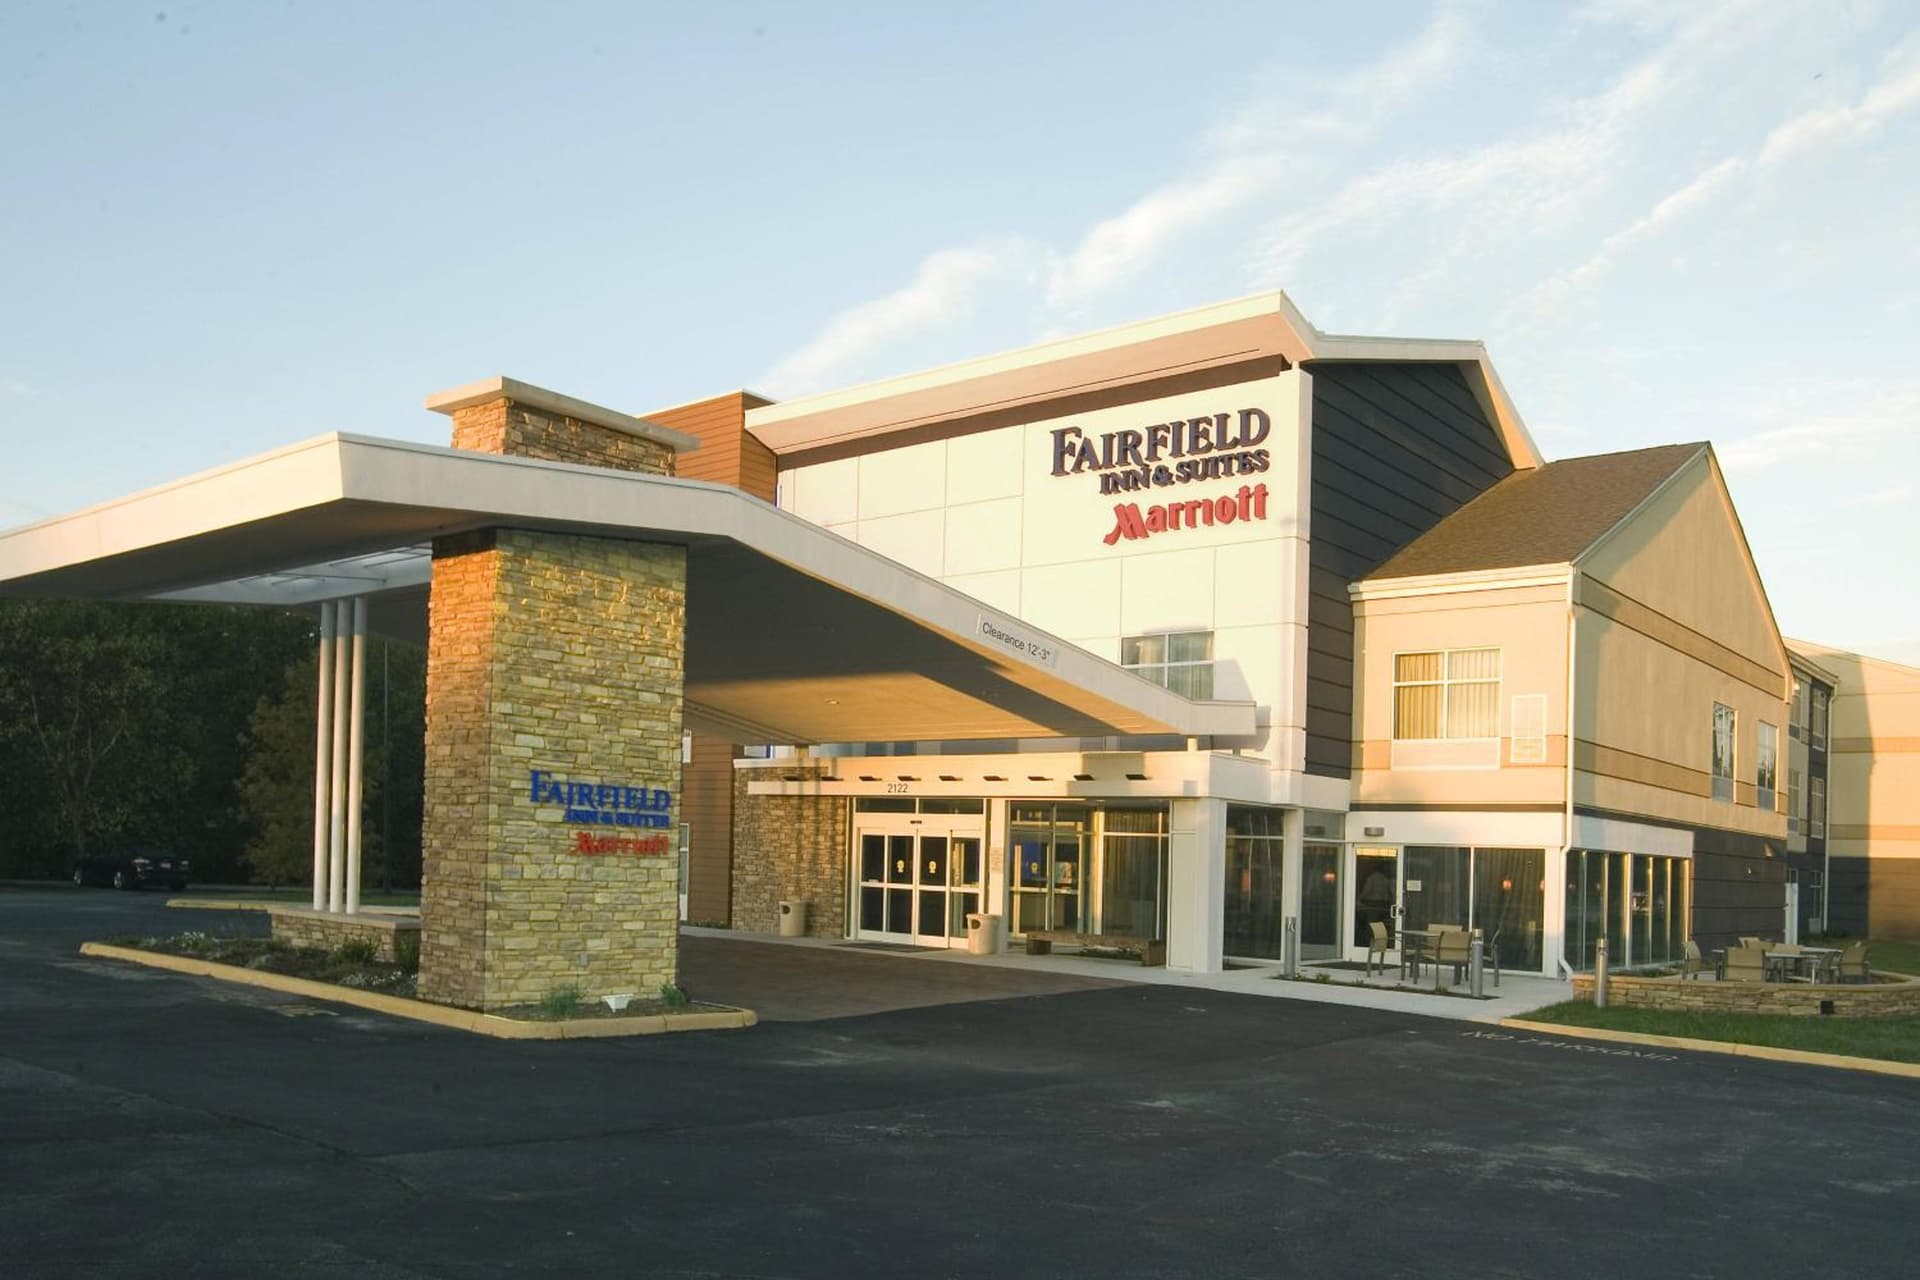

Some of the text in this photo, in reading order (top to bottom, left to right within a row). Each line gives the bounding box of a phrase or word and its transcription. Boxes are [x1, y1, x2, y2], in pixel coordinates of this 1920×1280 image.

[1050, 407, 1270, 477] FAIRFIELD
[1103, 483, 1269, 545] Marriott
[982, 622, 1025, 650] Clearance
[530, 769, 672, 810] FAIRFIELD
[887, 783, 908, 793] 2122
